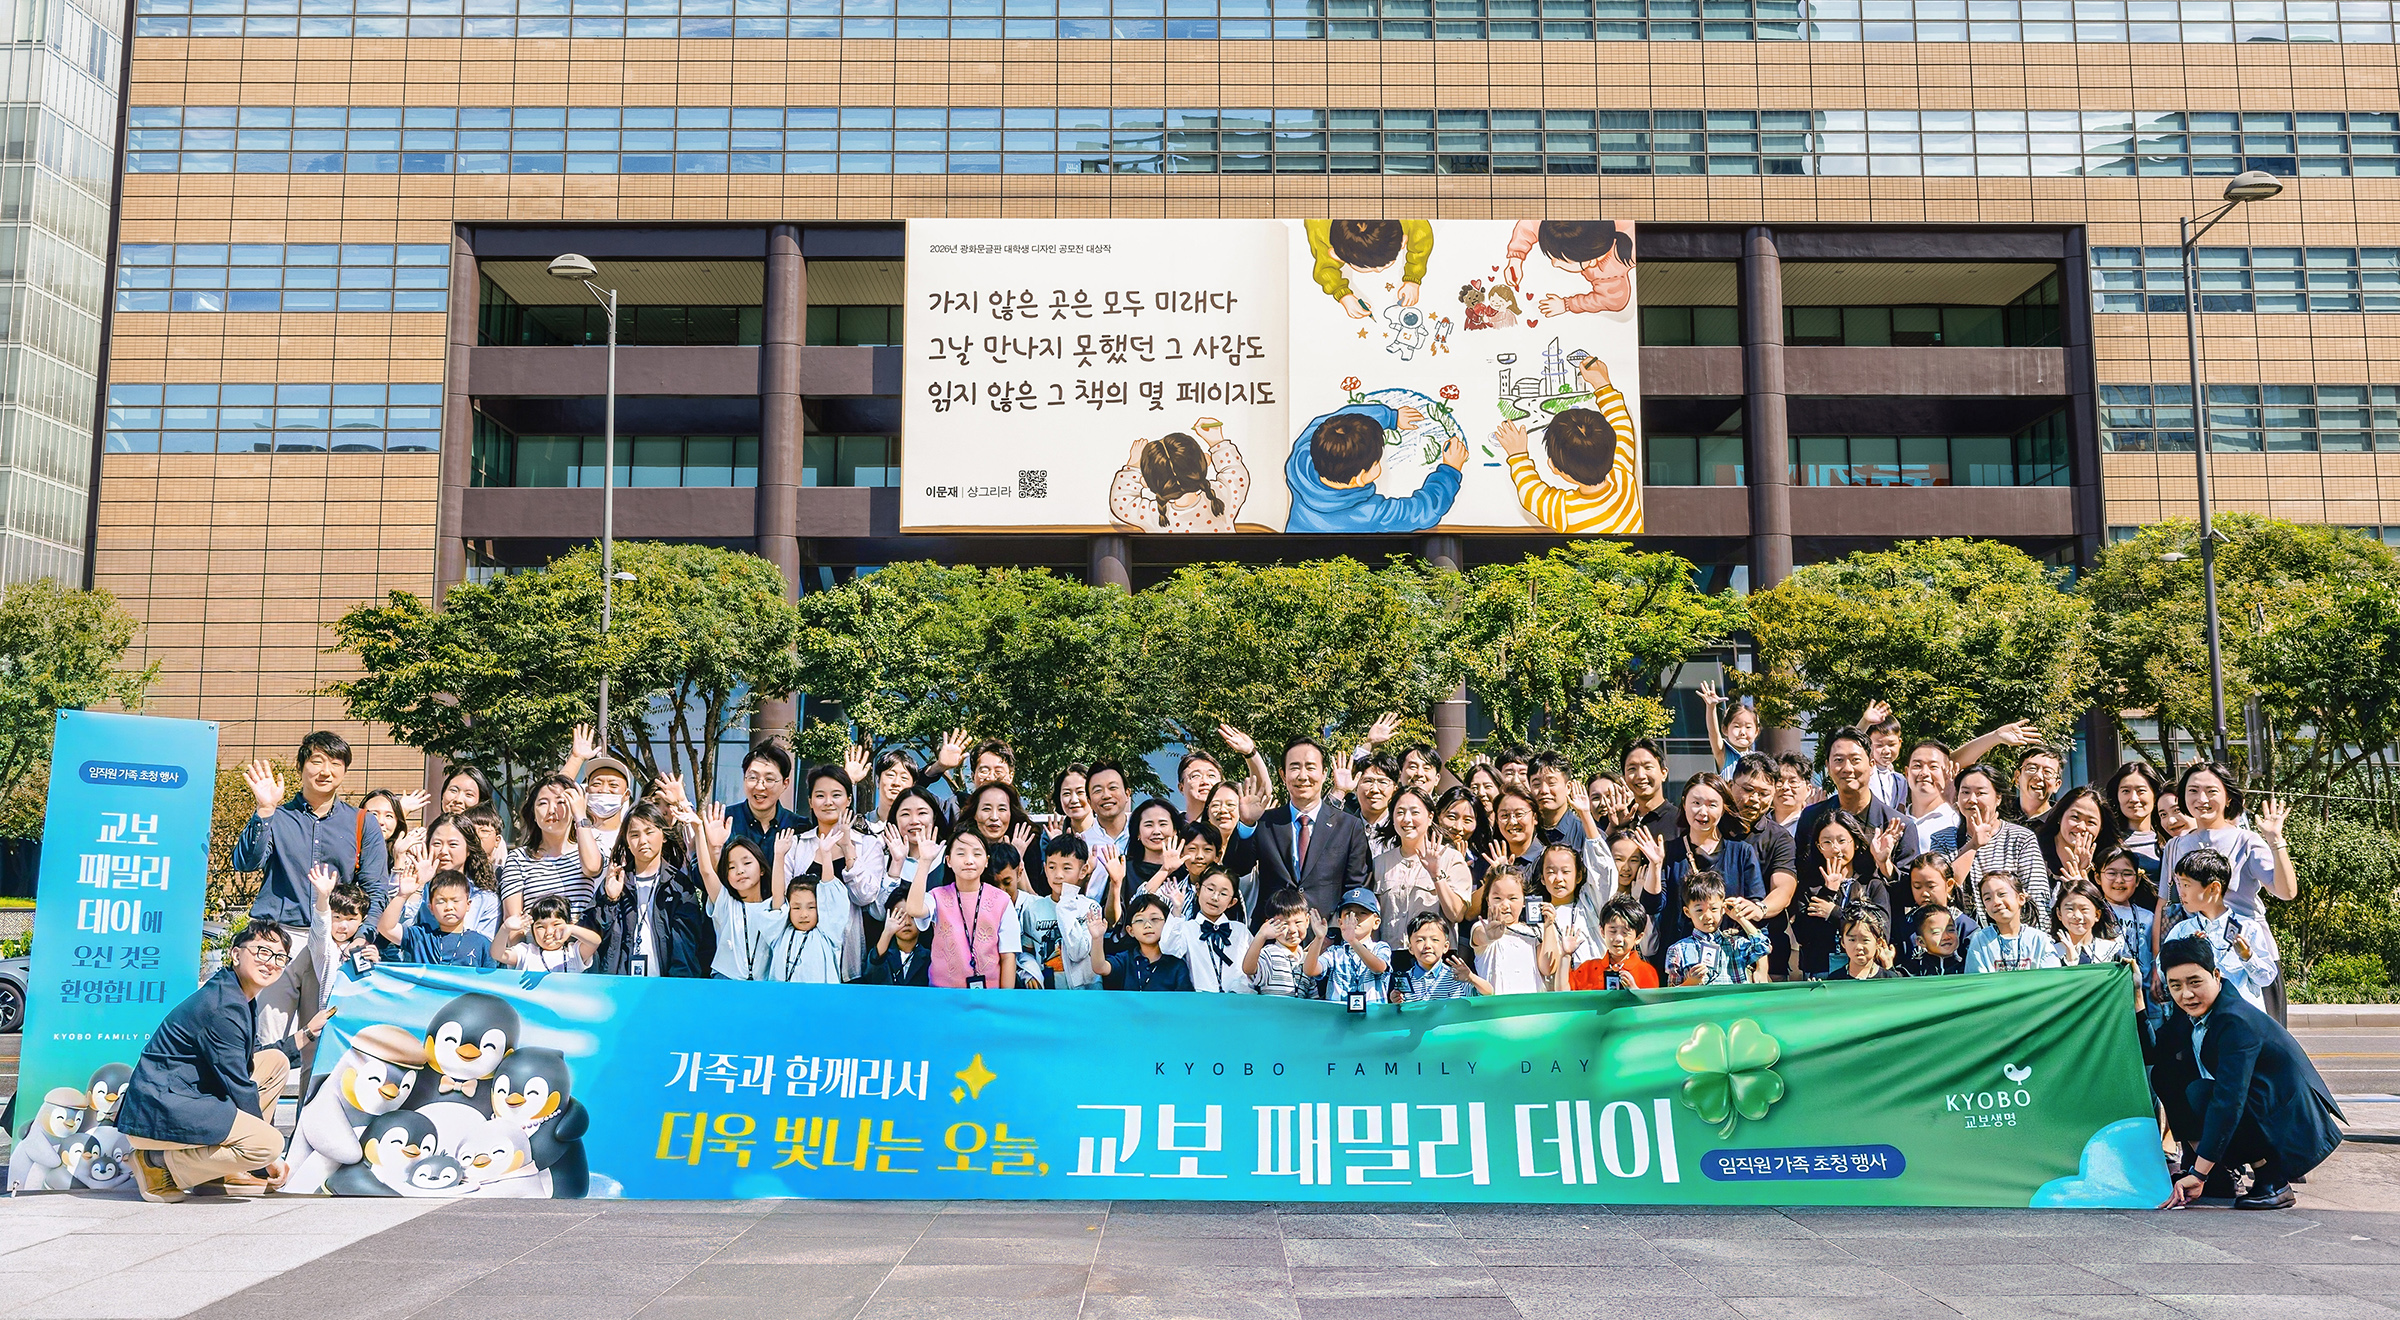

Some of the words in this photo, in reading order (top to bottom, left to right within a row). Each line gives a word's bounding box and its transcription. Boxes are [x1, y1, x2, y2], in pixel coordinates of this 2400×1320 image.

[929, 244, 958, 254] 2026년
[959, 244, 1003, 255] 광화문글판
[1003, 244, 1030, 254] 대학생
[1031, 244, 1057, 254] 디자인
[1058, 244, 1084, 254] 공모전
[1085, 244, 1112, 254] 대상작
[928, 290, 978, 314] 가지
[988, 288, 1039, 322] 않은
[1048, 288, 1093, 321] 곳은
[1102, 290, 1145, 318] 모두
[1155, 290, 1238, 314] 미래다
[928, 335, 974, 366] 그날
[983, 334, 1062, 364] 만나지
[1072, 333, 1156, 368] 못했던
[1165, 337, 1183, 360] 그
[1192, 334, 1266, 367] 사람도
[927, 380, 977, 413] 읽지
[987, 380, 1038, 413] 않은
[1047, 383, 1066, 406] 그
[1075, 379, 1128, 411] 책의
[1139, 380, 1164, 412] 몇
[1175, 380, 1276, 406] 페이지도
[925, 485, 959, 499] 이문재
[967, 485, 1012, 499] 샹그리라
[89, 766, 117, 779] 임직원
[118, 769, 138, 781] 가족
[139, 770, 159, 782] 초청
[160, 771, 179, 783] 행사
[96, 812, 159, 845] 교보
[76, 854, 171, 891] 패밀리
[1352, 889, 1361, 898] B
[77, 899, 163, 935] 데이에
[72, 945, 113, 970] 오신
[120, 945, 161, 970] 것을
[60, 979, 168, 1004] 환영합니다
[53, 1033, 92, 1041] KYOBO
[97, 1033, 138, 1041] FAMILY
[664, 1051, 777, 1096] 가족과
[786, 1054, 930, 1101] 함께라서
[1155, 1061, 1285, 1076] KYOBO
[1327, 1060, 1477, 1076] FAMILY
[1520, 1058, 1589, 1075] DAY
[1946, 1089, 2031, 1112] KYOBO
[1964, 1112, 2017, 1129] 교보생명
[655, 1111, 757, 1169] 더욱
[772, 1116, 924, 1174] 빛나는
[937, 1121, 1050, 1176] 오늘,
[1066, 1103, 1228, 1179] 교보
[1250, 1101, 1491, 1185] 패밀리
[1514, 1097, 1681, 1185] 데이
[1718, 1156, 1772, 1175] 임직원
[1773, 1155, 1810, 1174] 가족
[1813, 1154, 1849, 1173] 초청
[1850, 1152, 1888, 1173] 행사
